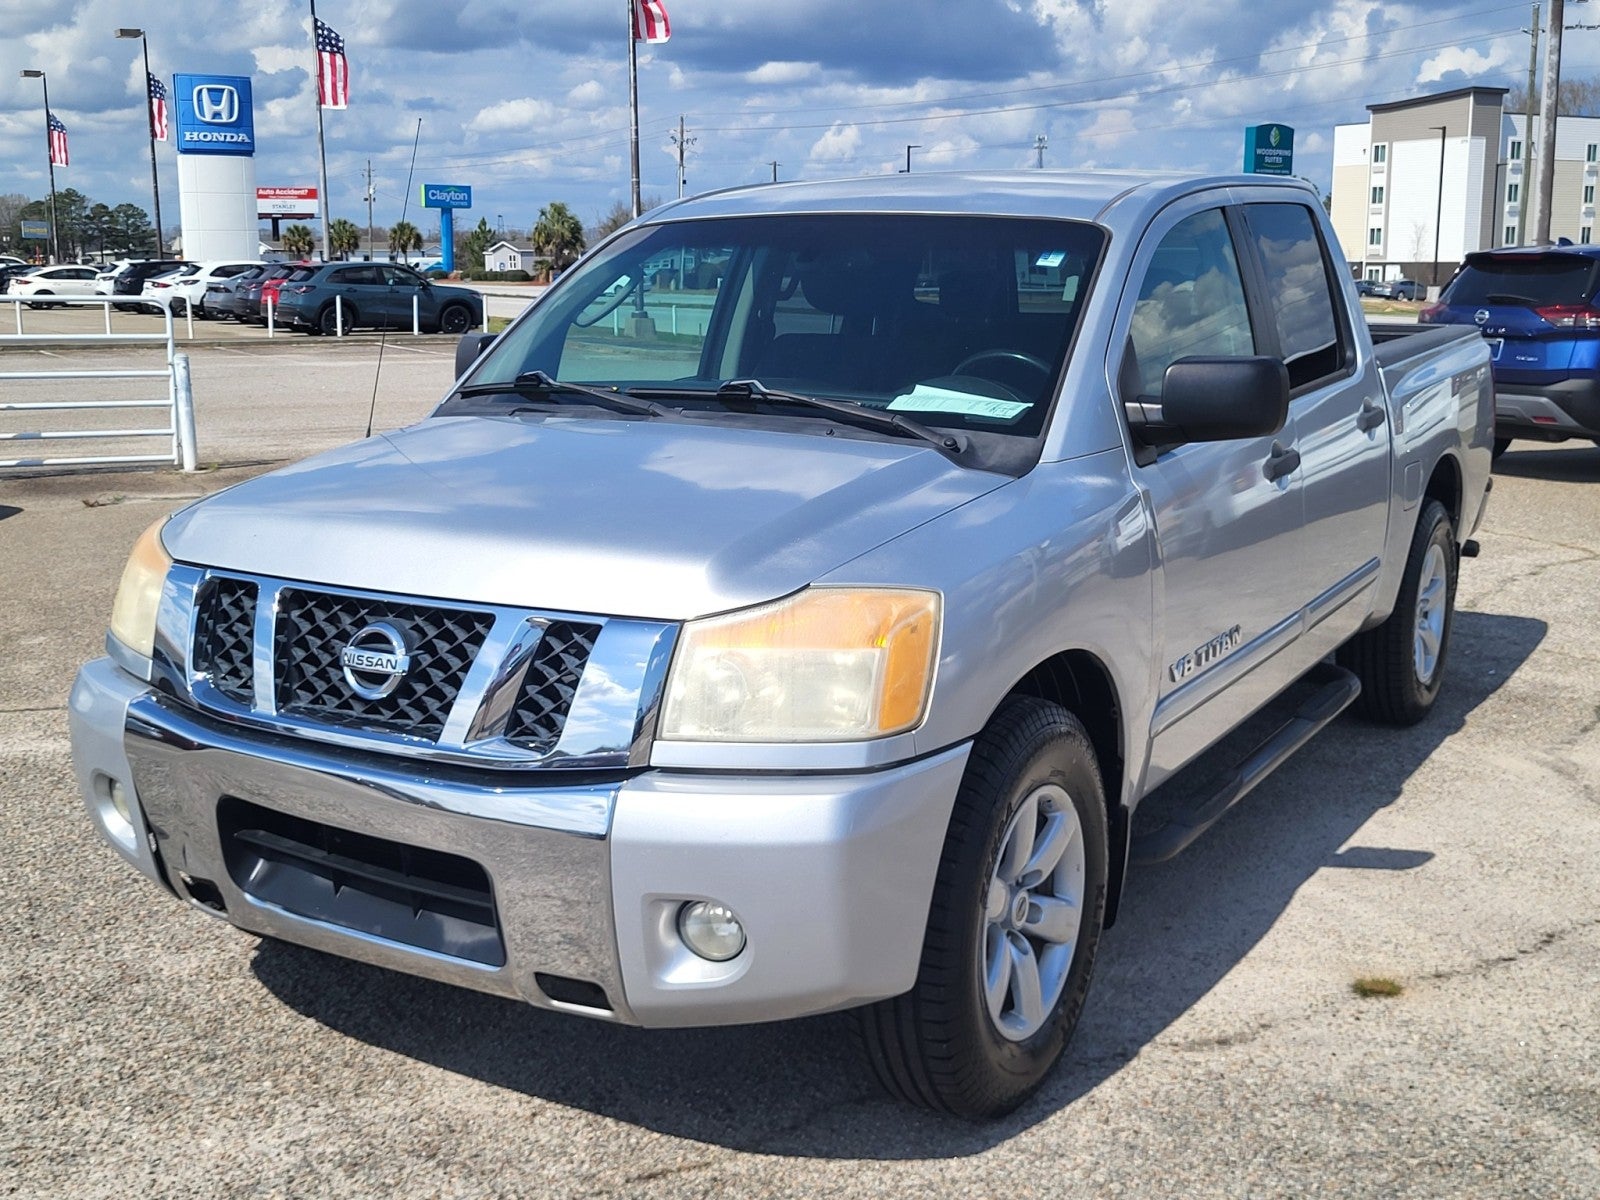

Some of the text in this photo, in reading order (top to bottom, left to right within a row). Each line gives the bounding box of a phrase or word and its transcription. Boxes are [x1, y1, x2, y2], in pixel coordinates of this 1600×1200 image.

[184, 131, 252, 143] HONDA
[428, 189, 468, 203] Clayton
[343, 652, 399, 671] NISSAN
[1168, 624, 1242, 683] V8 TITAN
